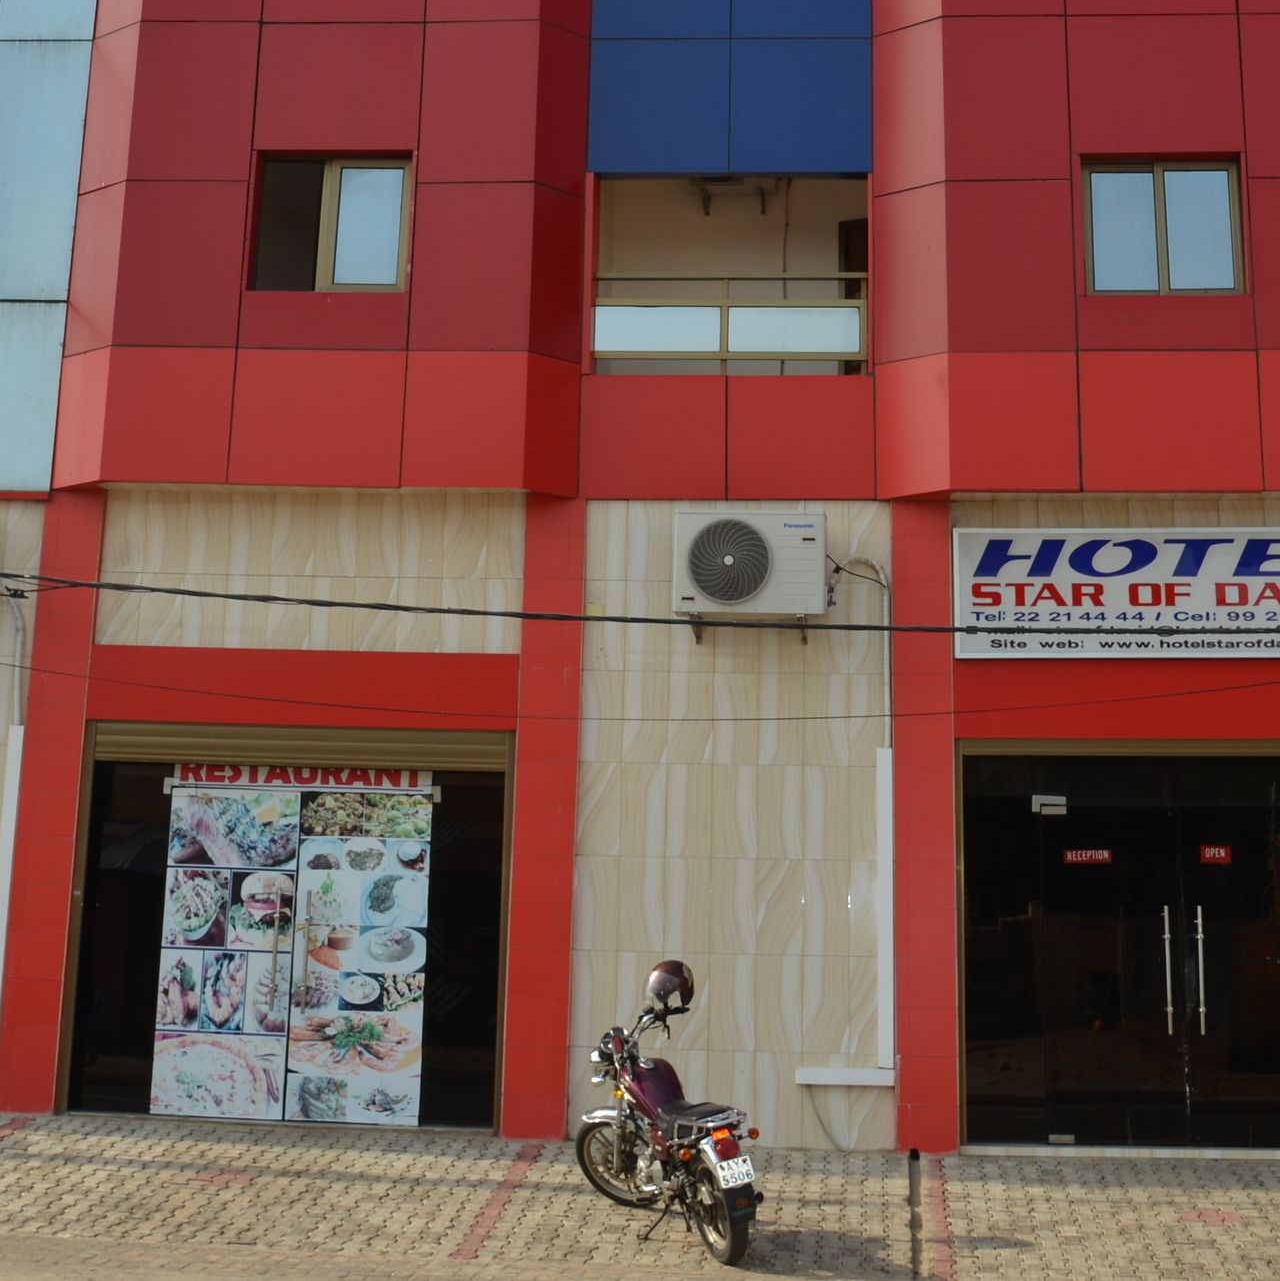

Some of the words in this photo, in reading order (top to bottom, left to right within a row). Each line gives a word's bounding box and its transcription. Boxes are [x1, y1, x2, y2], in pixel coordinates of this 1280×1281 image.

[971, 582, 1105, 607] STAR
[1128, 582, 1191, 607] OF
[971, 611, 1006, 622] Tel:
[1013, 611, 1040, 622] 22
[1049, 611, 1071, 622] 21
[1078, 611, 1112, 622] 44
[1115, 611, 1145, 622] 44
[1154, 611, 1162, 622] /
[1173, 611, 1216, 622] Cel:
[1227, 610, 1256, 622] 99
[990, 639, 1028, 649] Site
[1039, 639, 1085, 649] web:
[179, 763, 419, 788] RESTAURANT
[1066, 849, 1109, 861] RECEPTION
[1205, 847, 1226, 858] OPEN
[722, 1168, 754, 1186] 5506
